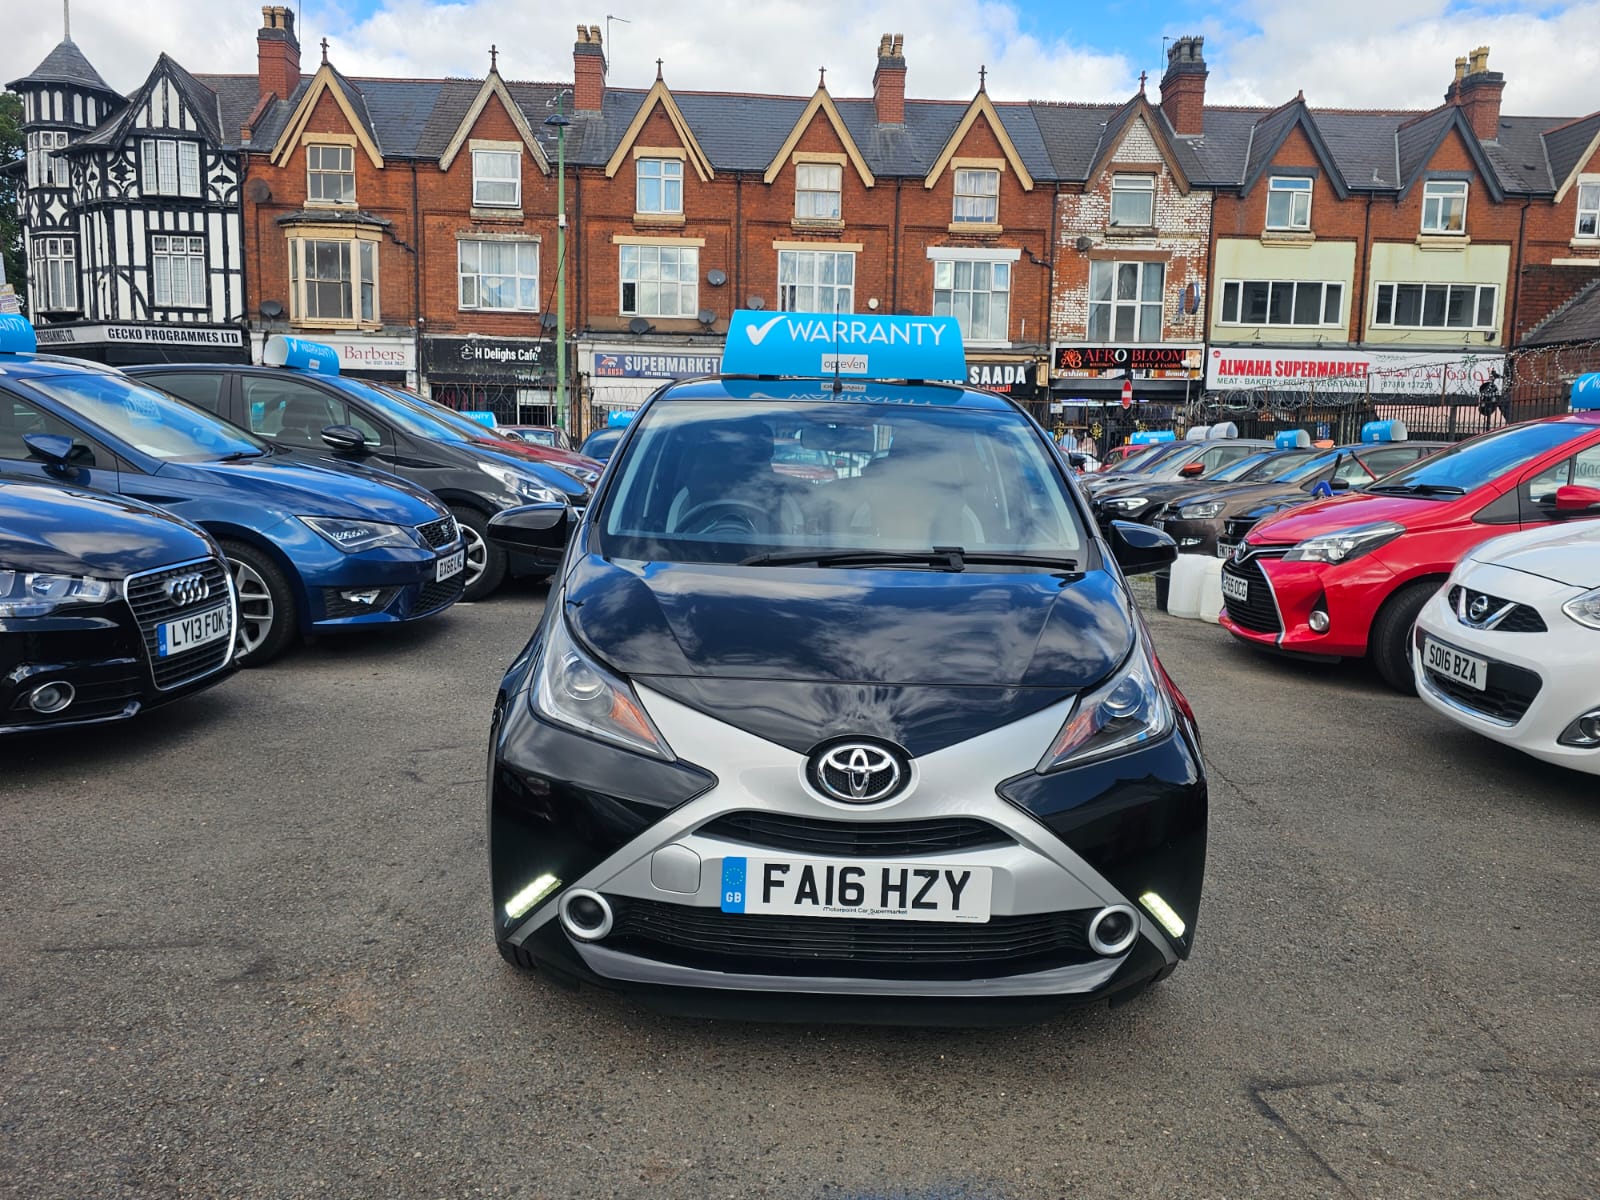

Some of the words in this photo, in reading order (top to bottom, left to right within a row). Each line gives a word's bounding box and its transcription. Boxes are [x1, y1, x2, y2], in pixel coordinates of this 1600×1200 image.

[107, 328, 142, 340] GECKO
[145, 329, 219, 343] PROGRAMMES
[221, 332, 239, 344] LTD
[787, 319, 947, 346] WARRANTY
[344, 345, 405, 361] Barbers
[475, 347, 482, 359] H
[484, 348, 516, 362] Delighs
[1083, 349, 1127, 364] AFRO
[1131, 349, 1185, 362] BLOOM
[624, 356, 719, 373] SUPERMARKET
[1218, 360, 1271, 377] ALWAHA
[1275, 361, 1370, 379] SUPERMARKET
[969, 366, 1026, 384] SAADA
[1217, 377, 1239, 385] MEAT
[1244, 378, 1276, 386] BAKERY
[172, 617, 202, 647] LY13
[204, 608, 225, 637] FOK
[1429, 644, 1452, 672] SO16
[1453, 653, 1477, 684] BZA
[761, 862, 866, 907] FA16
[880, 866, 971, 911] HZY
[725, 891, 742, 904] GB
